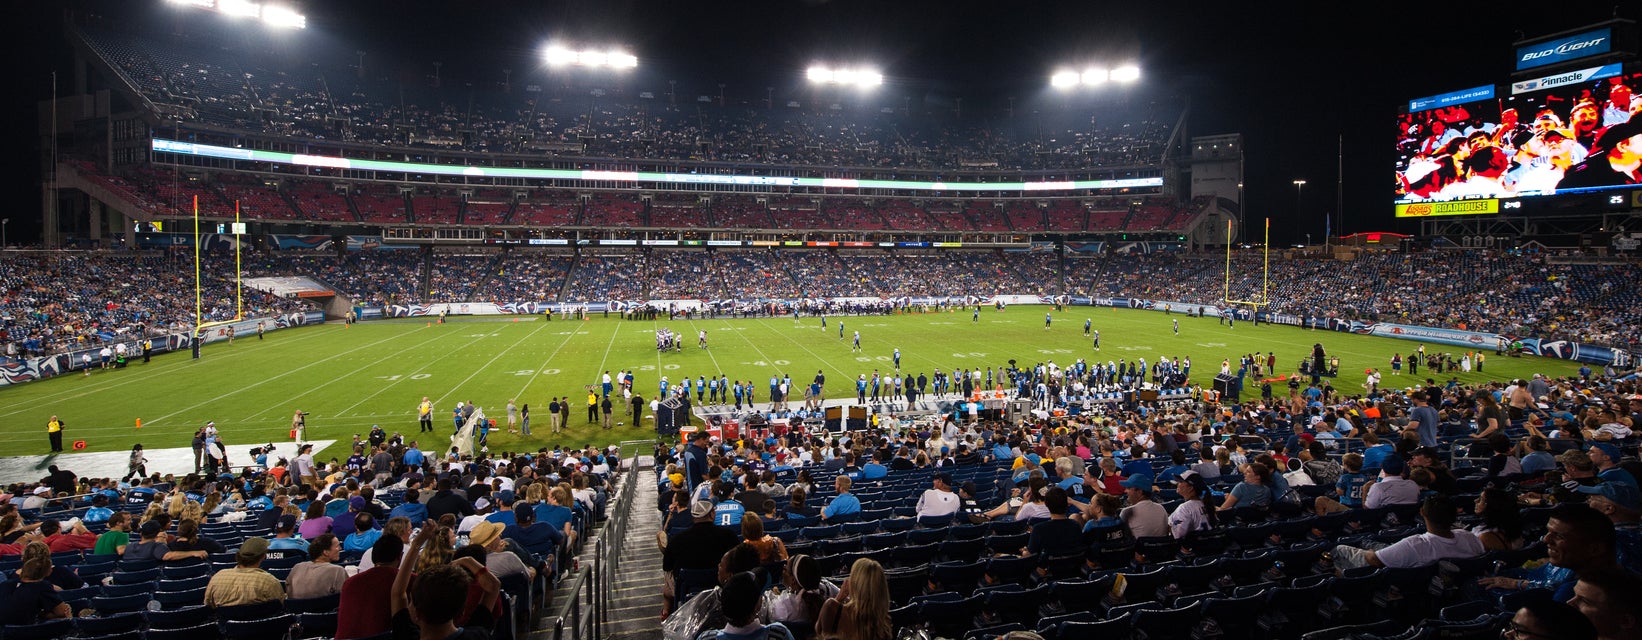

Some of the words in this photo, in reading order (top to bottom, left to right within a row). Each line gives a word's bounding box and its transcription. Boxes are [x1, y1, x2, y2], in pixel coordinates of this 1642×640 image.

[1521, 49, 1554, 61] BUD
[1560, 38, 1606, 53] LIGHT
[1541, 72, 1583, 87] Pinnacle
[1436, 201, 1488, 212] ROADHOUSE
[172, 236, 187, 245] LP
[1088, 295, 1113, 306] TTANS
[1272, 312, 1298, 325] TITAN
[514, 368, 561, 376] 20
[75, 441, 84, 449] G
[266, 552, 284, 560] MASON
